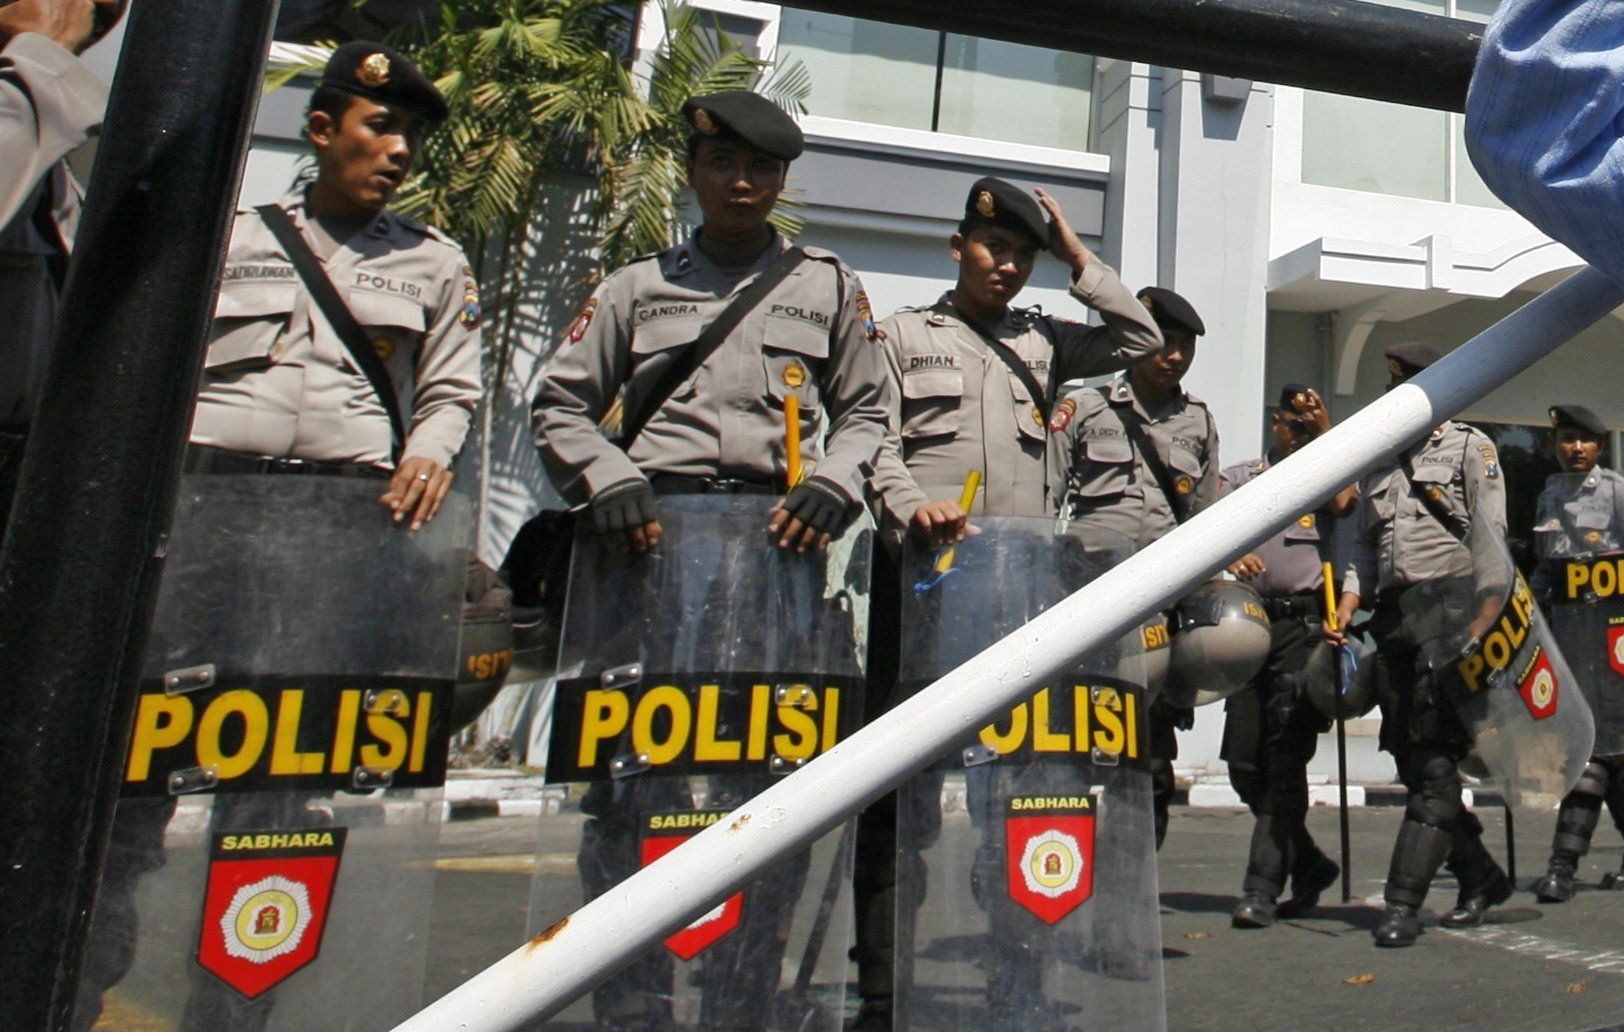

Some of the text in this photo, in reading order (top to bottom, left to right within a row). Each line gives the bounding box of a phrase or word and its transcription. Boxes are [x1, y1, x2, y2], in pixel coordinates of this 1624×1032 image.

[356, 273, 422, 299] POLISI
[770, 304, 829, 326] POLISI
[910, 355, 954, 369] DHIAN
[1421, 456, 1454, 465] POLISI
[577, 684, 840, 768] POLISI
[978, 686, 1137, 759] OLISI
[127, 689, 433, 782] POLISI
[1011, 797, 1090, 811] SABHARA
[650, 812, 732, 830] SABHA
[221, 832, 334, 851] SABHARA
